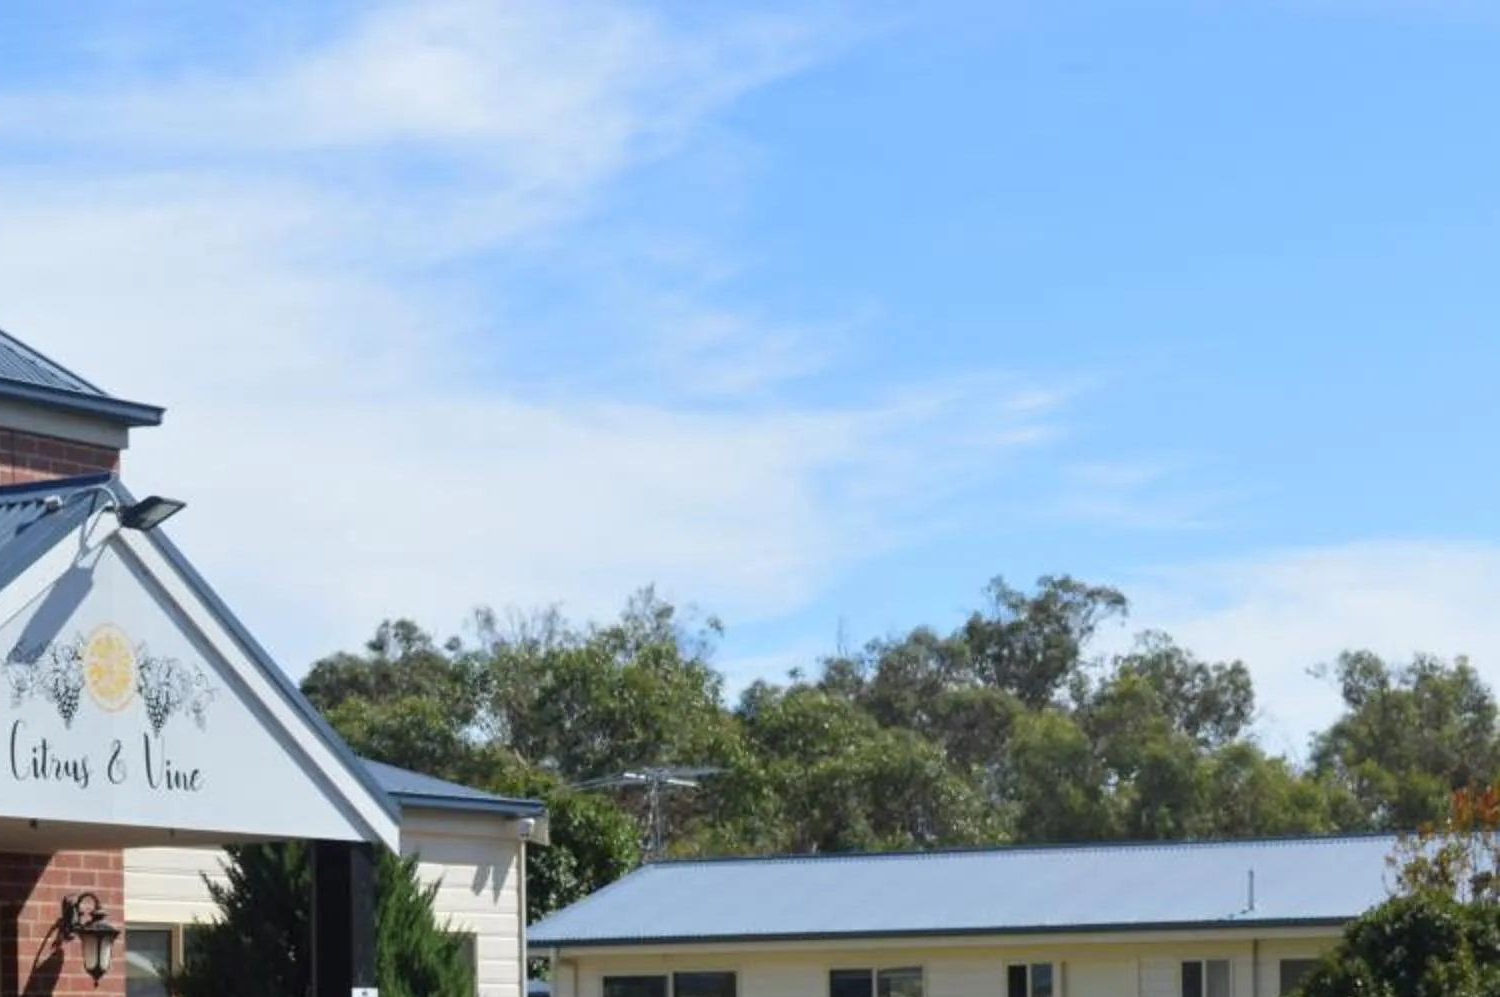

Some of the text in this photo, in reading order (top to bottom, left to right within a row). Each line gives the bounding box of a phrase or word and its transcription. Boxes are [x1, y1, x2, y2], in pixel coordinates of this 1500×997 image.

[9, 719, 205, 791] Citrus & Vine
